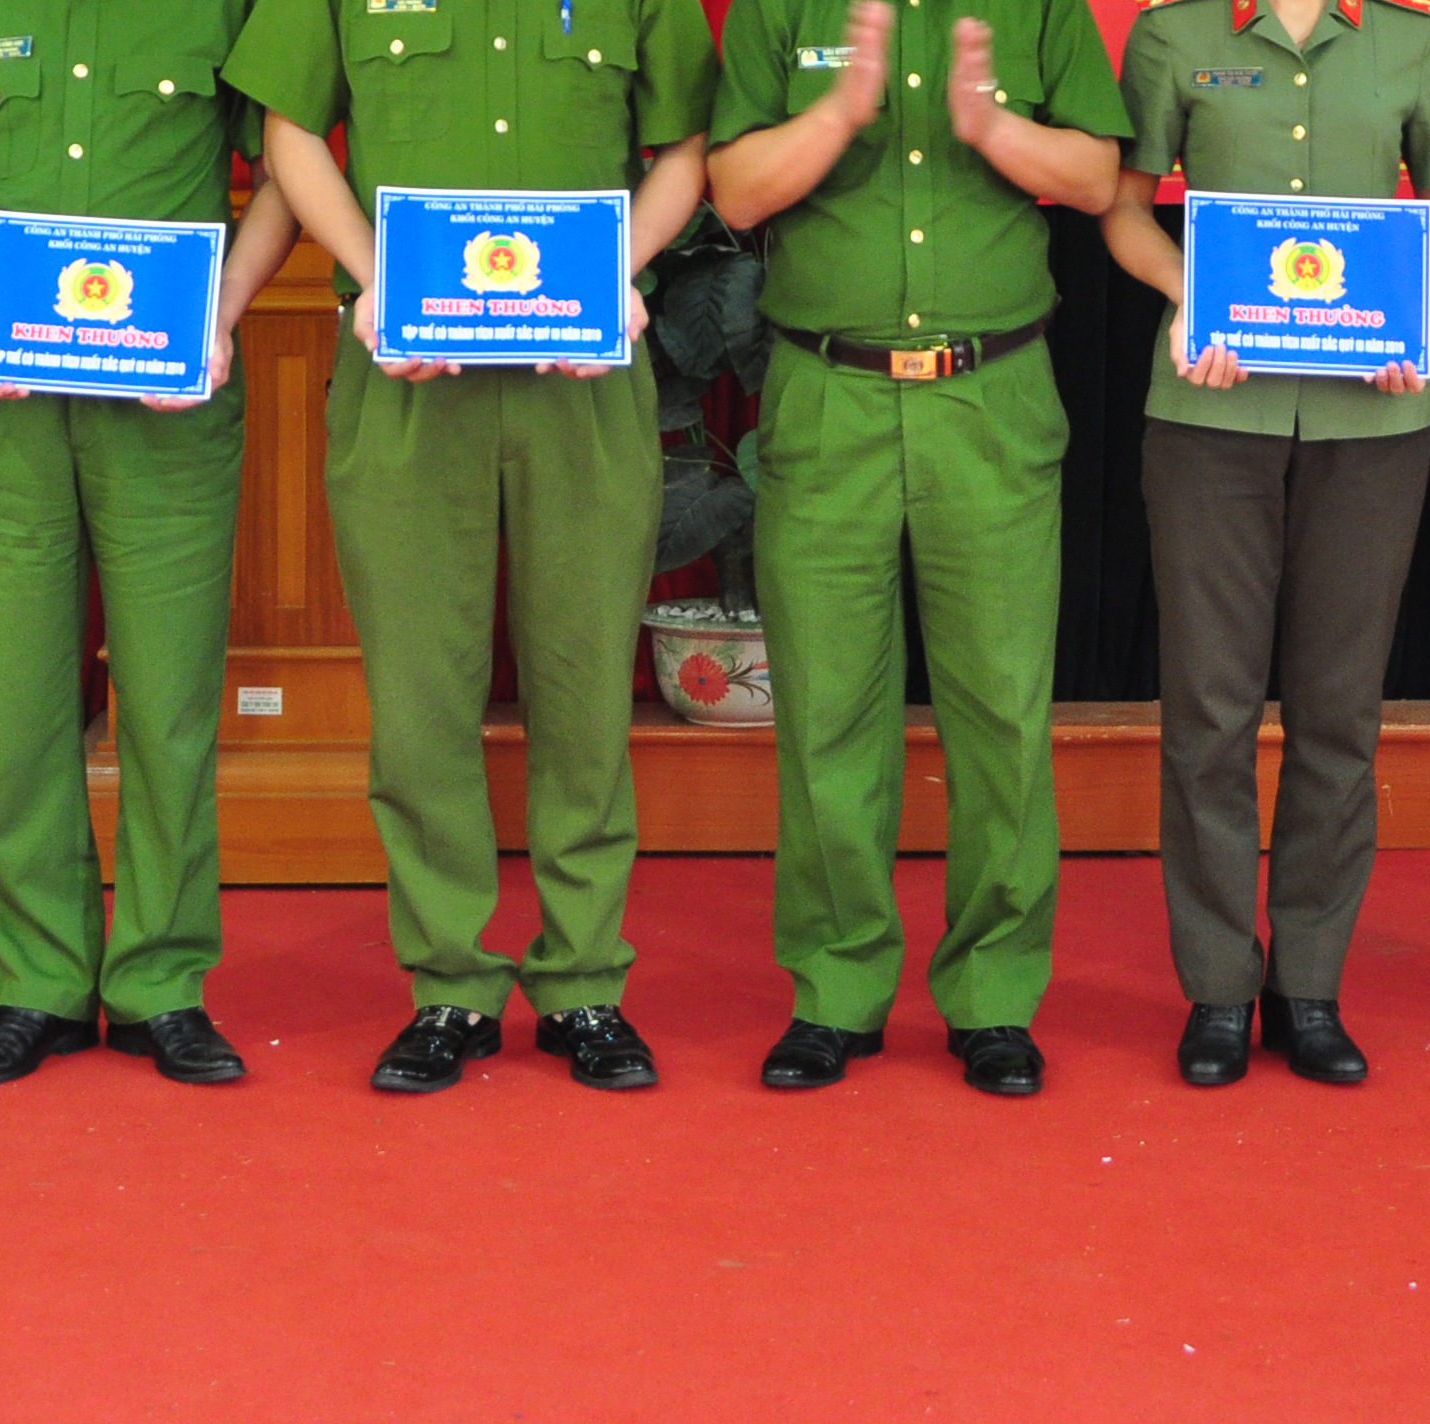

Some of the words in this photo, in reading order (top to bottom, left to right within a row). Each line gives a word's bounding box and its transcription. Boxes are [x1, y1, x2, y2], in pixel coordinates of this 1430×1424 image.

[422, 298, 484, 315] KHEN
[487, 294, 582, 316] THƯỞNG
[1229, 304, 1290, 323] KHEN
[1294, 304, 1386, 327] THƯỞNG
[12, 322, 73, 341] KHEN
[77, 325, 169, 348] THƯỞNG
